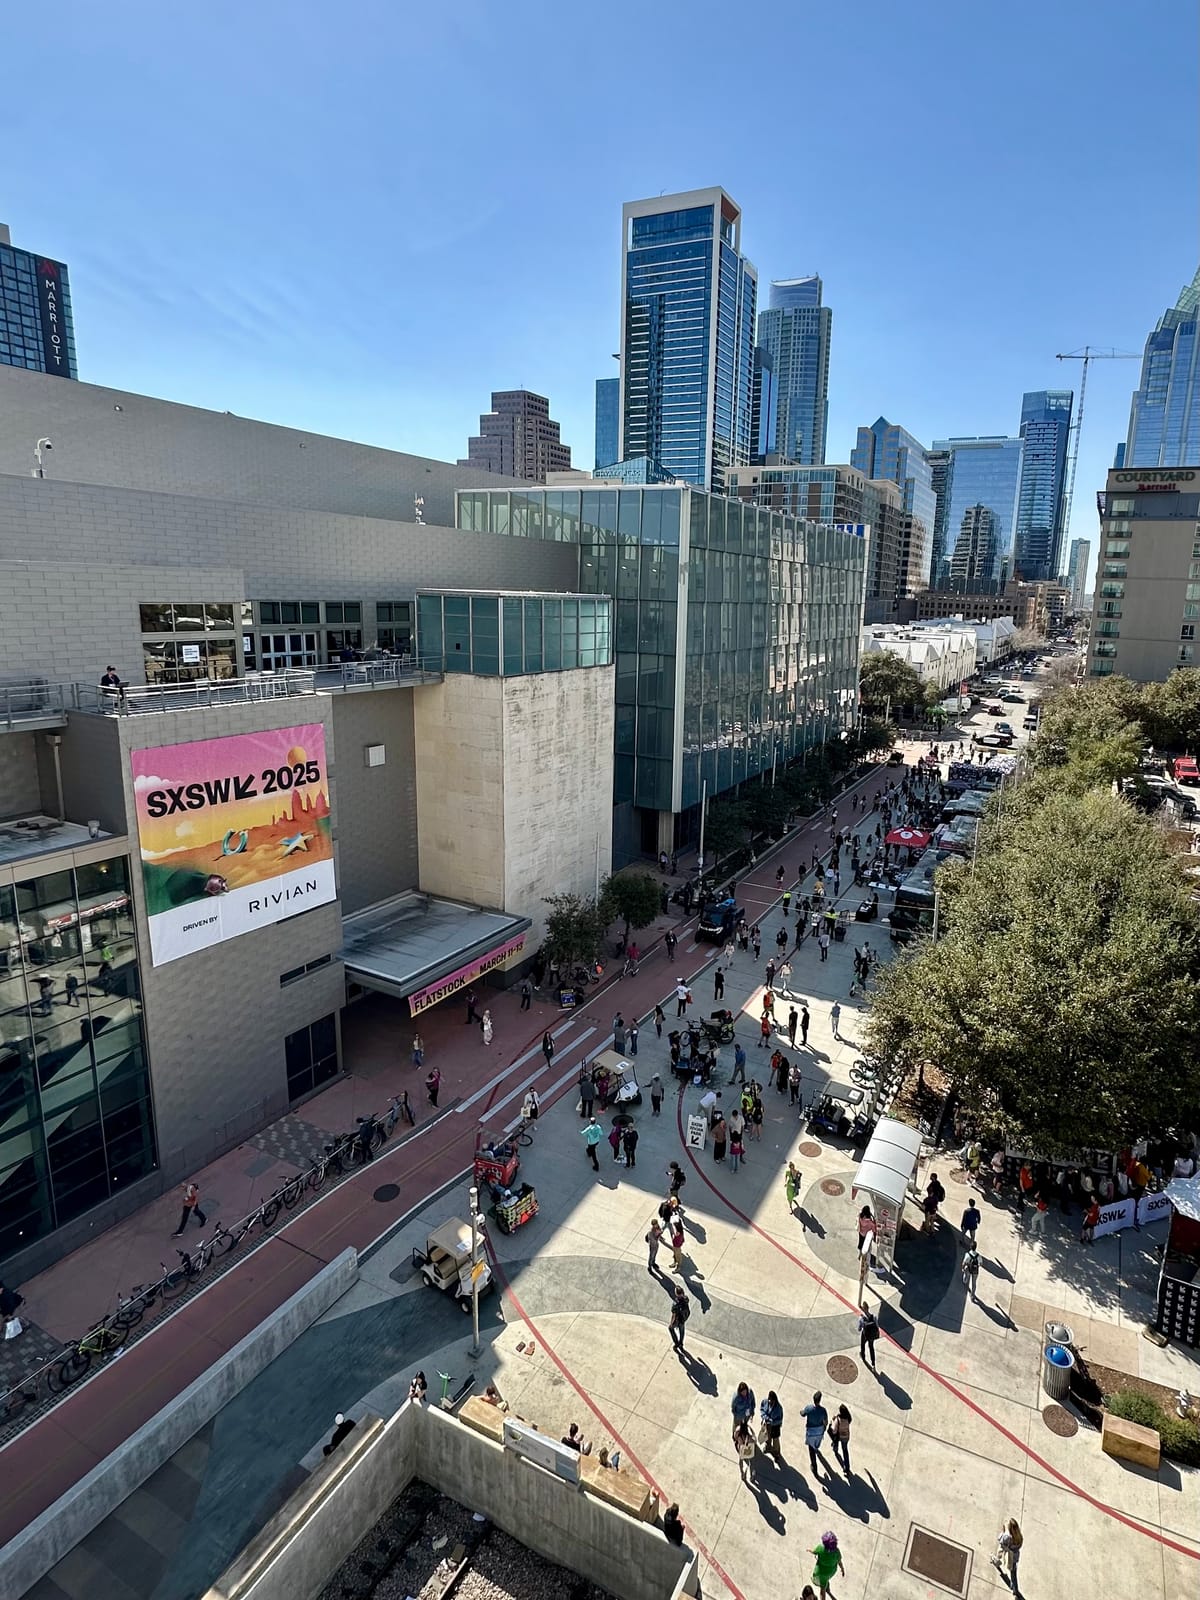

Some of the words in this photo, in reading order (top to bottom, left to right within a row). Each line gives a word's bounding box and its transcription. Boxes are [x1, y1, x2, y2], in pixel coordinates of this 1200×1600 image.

[45, 279, 62, 366] MARRIOTT
[1115, 471, 1196, 483] COURTYARD
[146, 777, 231, 818] SXSW
[261, 760, 321, 795] 2025
[182, 918, 208, 932] DRIVEN
[208, 915, 218, 924] BY
[248, 879, 318, 913] RIVIAN
[413, 975, 466, 1013] FLATSTOCK
[479, 950, 507, 975] MARCH
